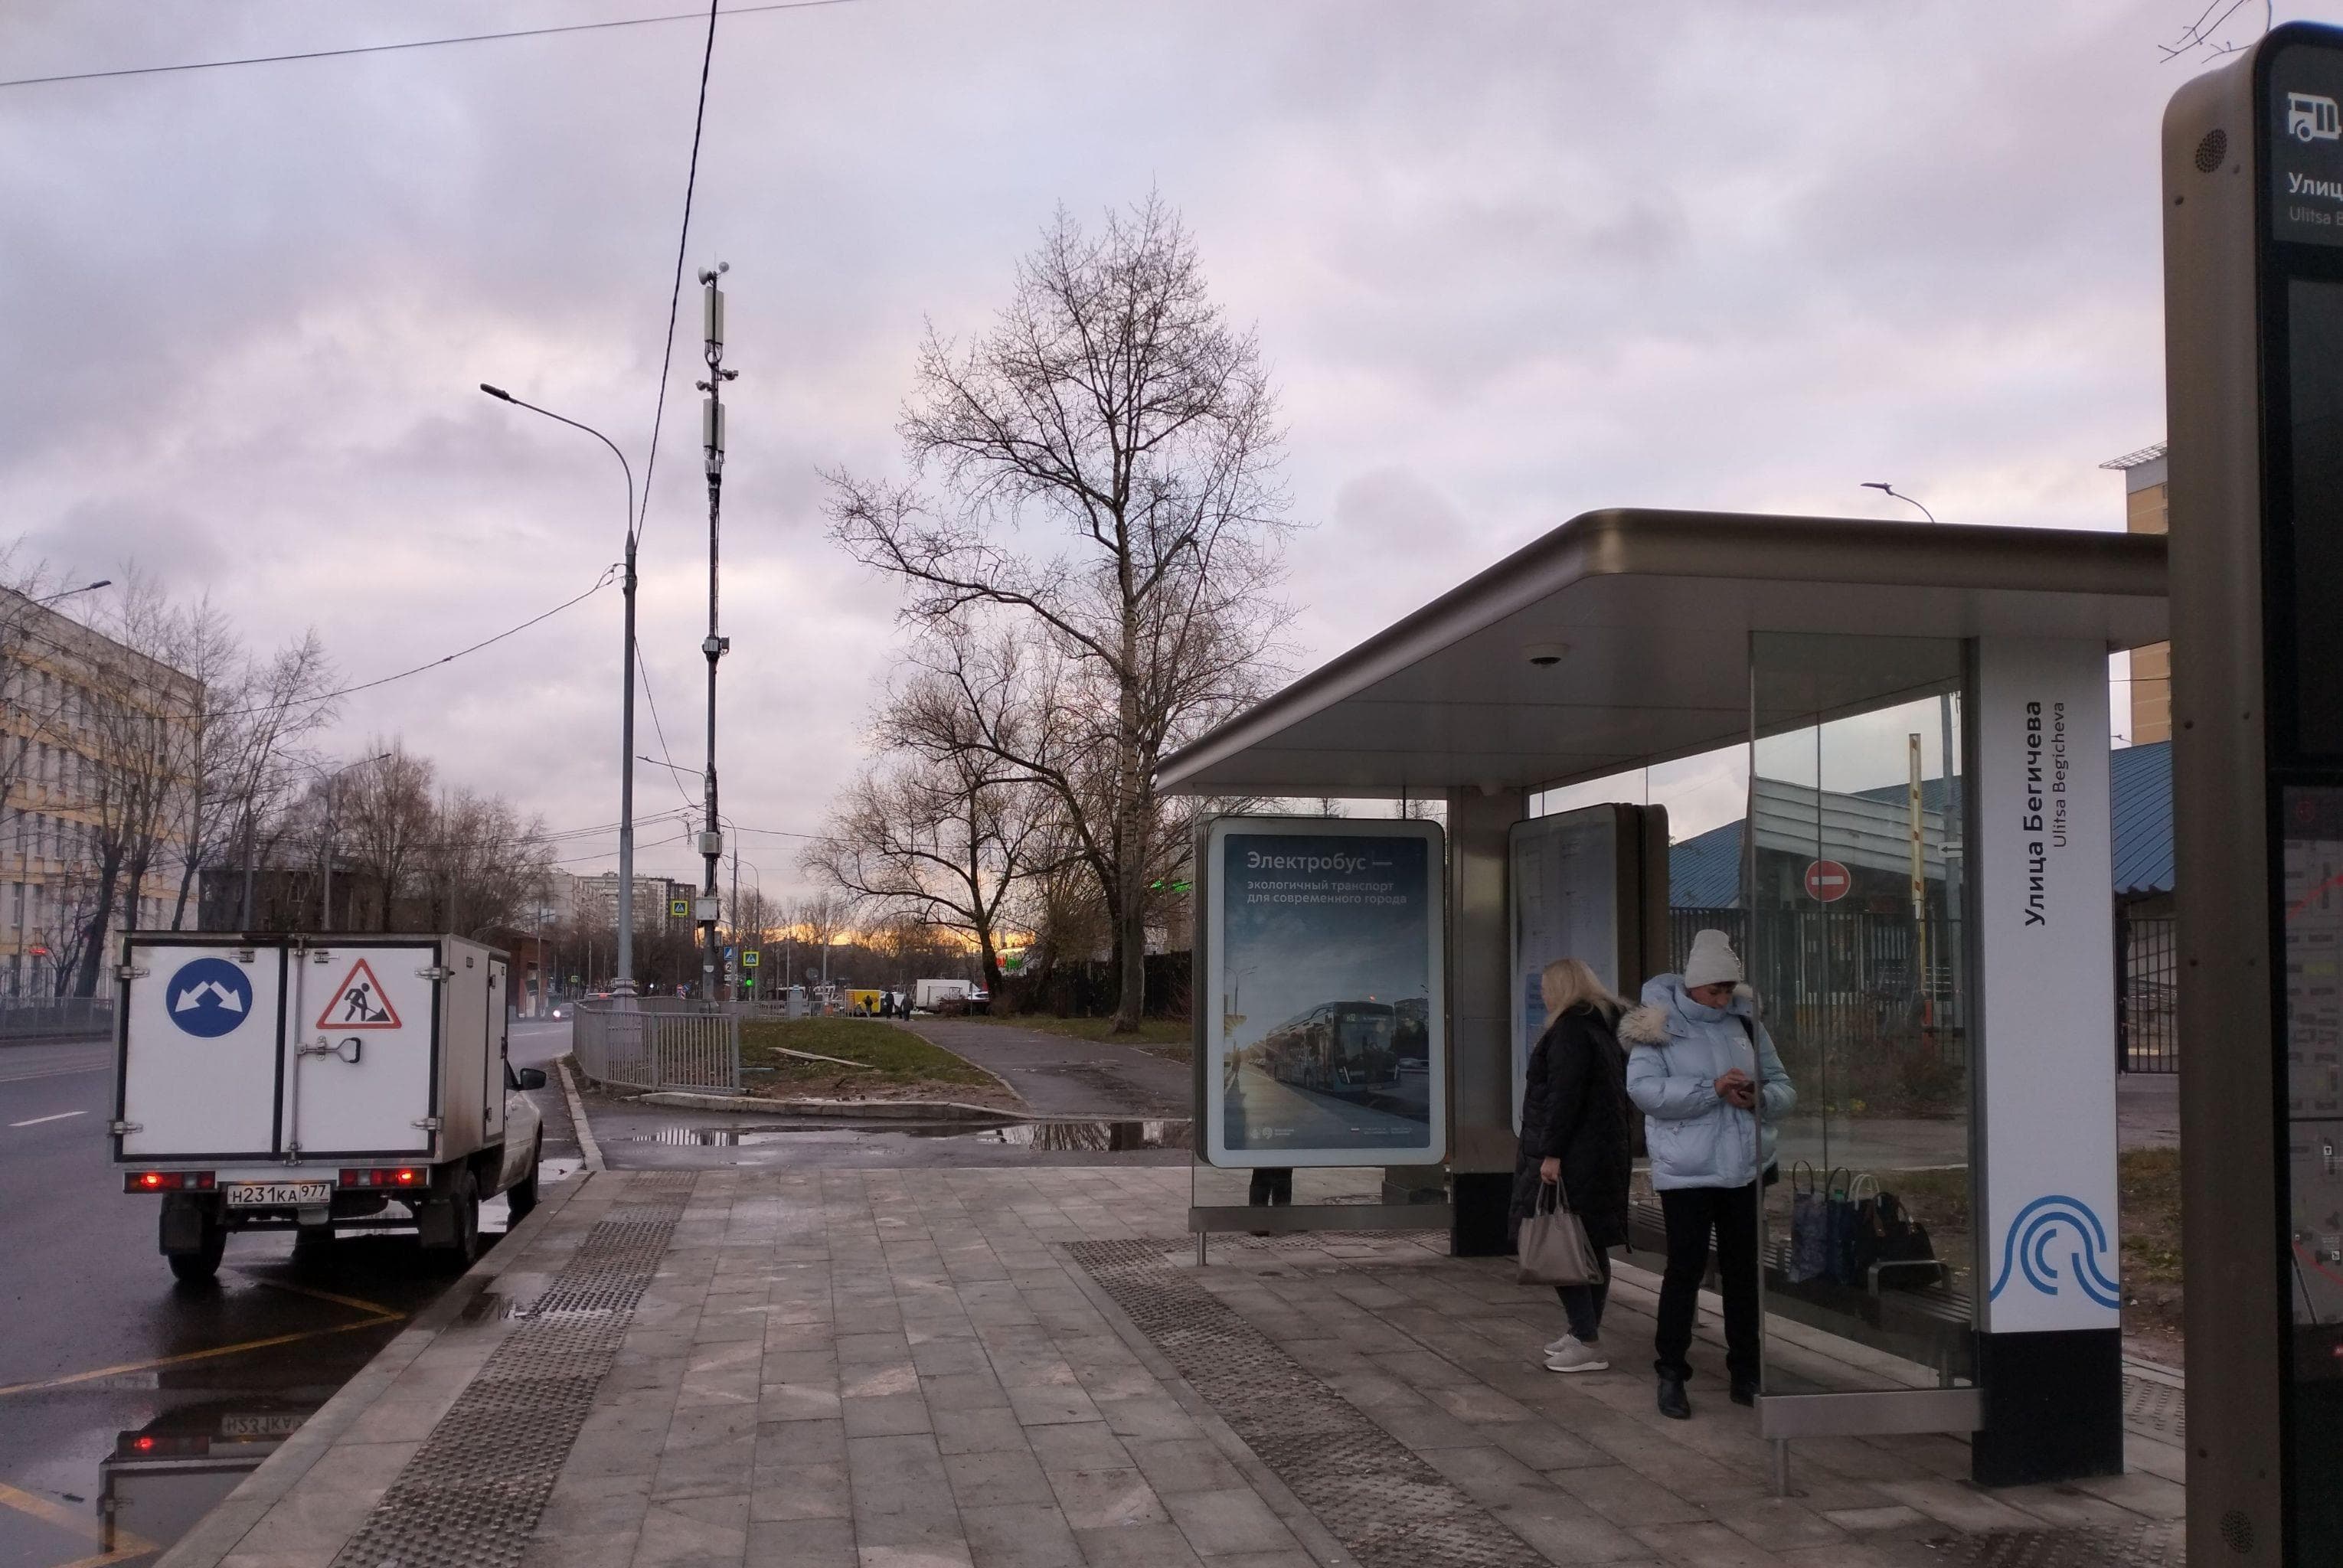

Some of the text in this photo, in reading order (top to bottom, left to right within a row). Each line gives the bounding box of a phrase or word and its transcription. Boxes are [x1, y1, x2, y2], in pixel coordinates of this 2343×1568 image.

[2289, 206, 2332, 225] Ulitsa
[2051, 702, 2069, 848] Ulitsa Begicheva
[2023, 701, 2047, 926] Улица Бегичева
[1247, 851, 1367, 874] Электробус
[1247, 880, 1394, 893] экологичный транспорт
[1247, 893, 1408, 906] для современного города
[232, 1184, 326, 1204] Н231КА 977
